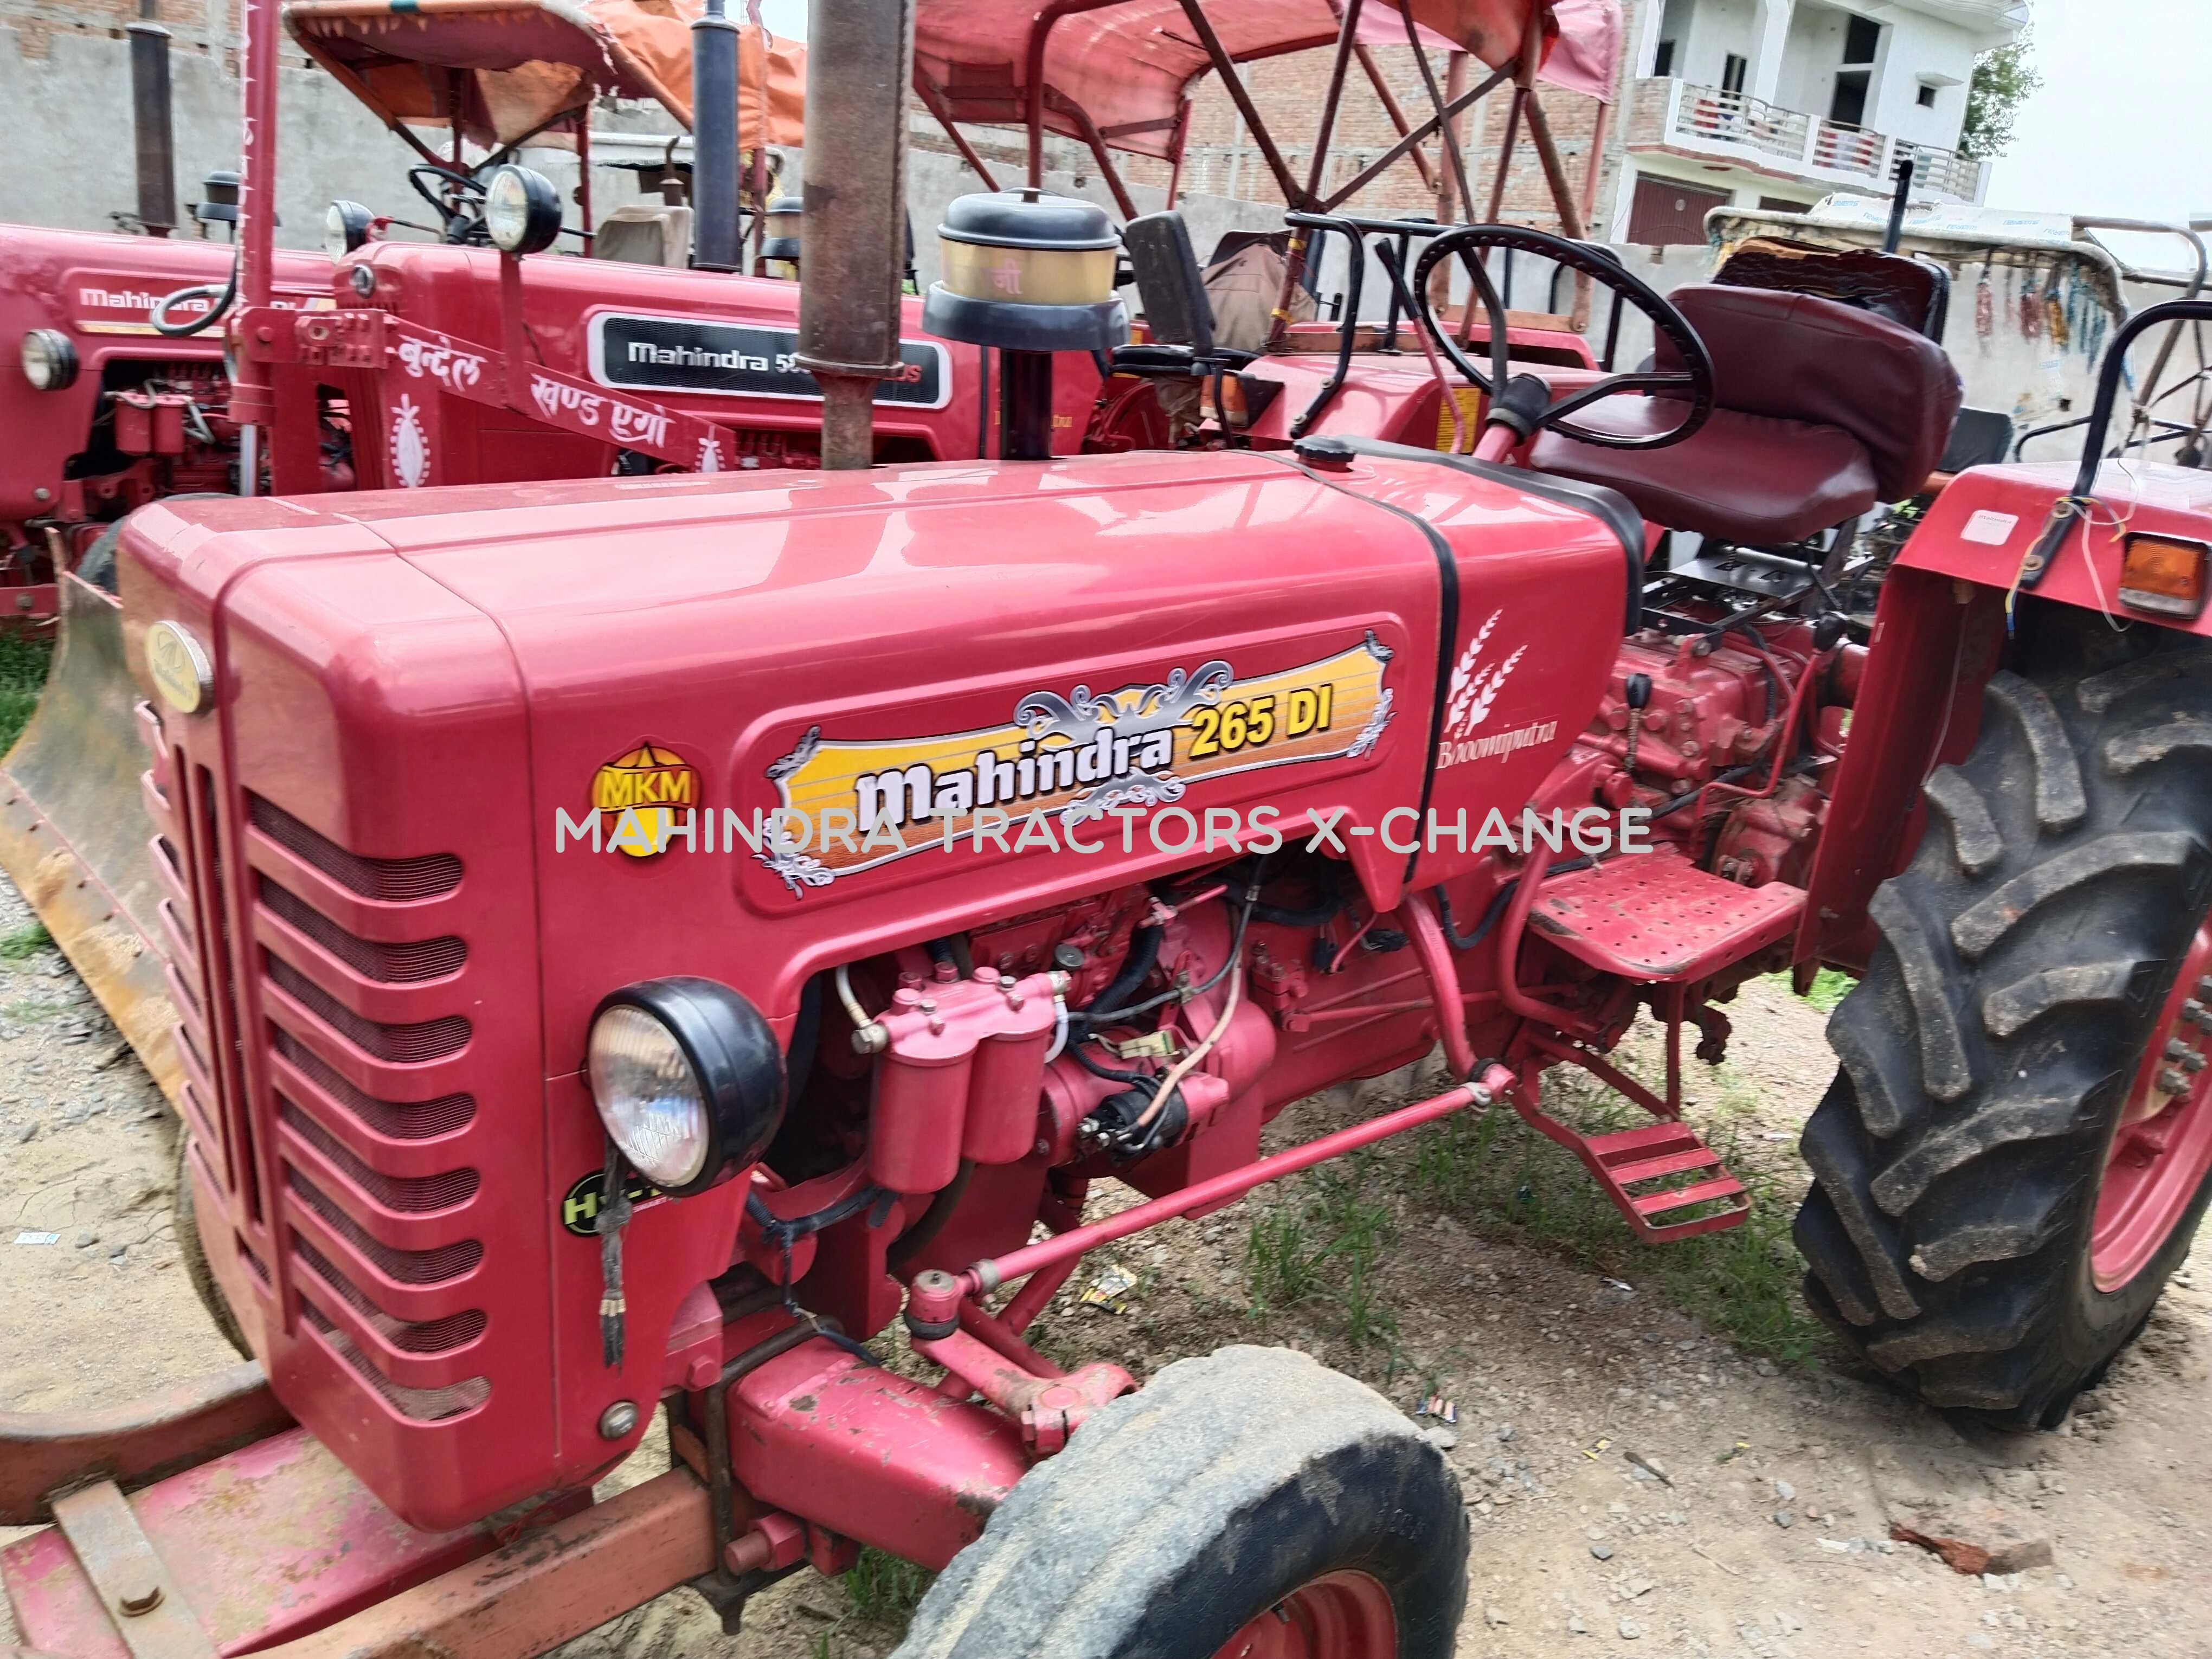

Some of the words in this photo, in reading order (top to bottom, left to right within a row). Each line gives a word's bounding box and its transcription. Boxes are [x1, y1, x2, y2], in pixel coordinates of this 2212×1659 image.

[627, 341, 769, 372] Mahindra
[854, 725, 1174, 833] Mahindra
[1188, 694, 1274, 757] 265
[1286, 683, 1333, 736] DI
[600, 770, 692, 808] MKM
